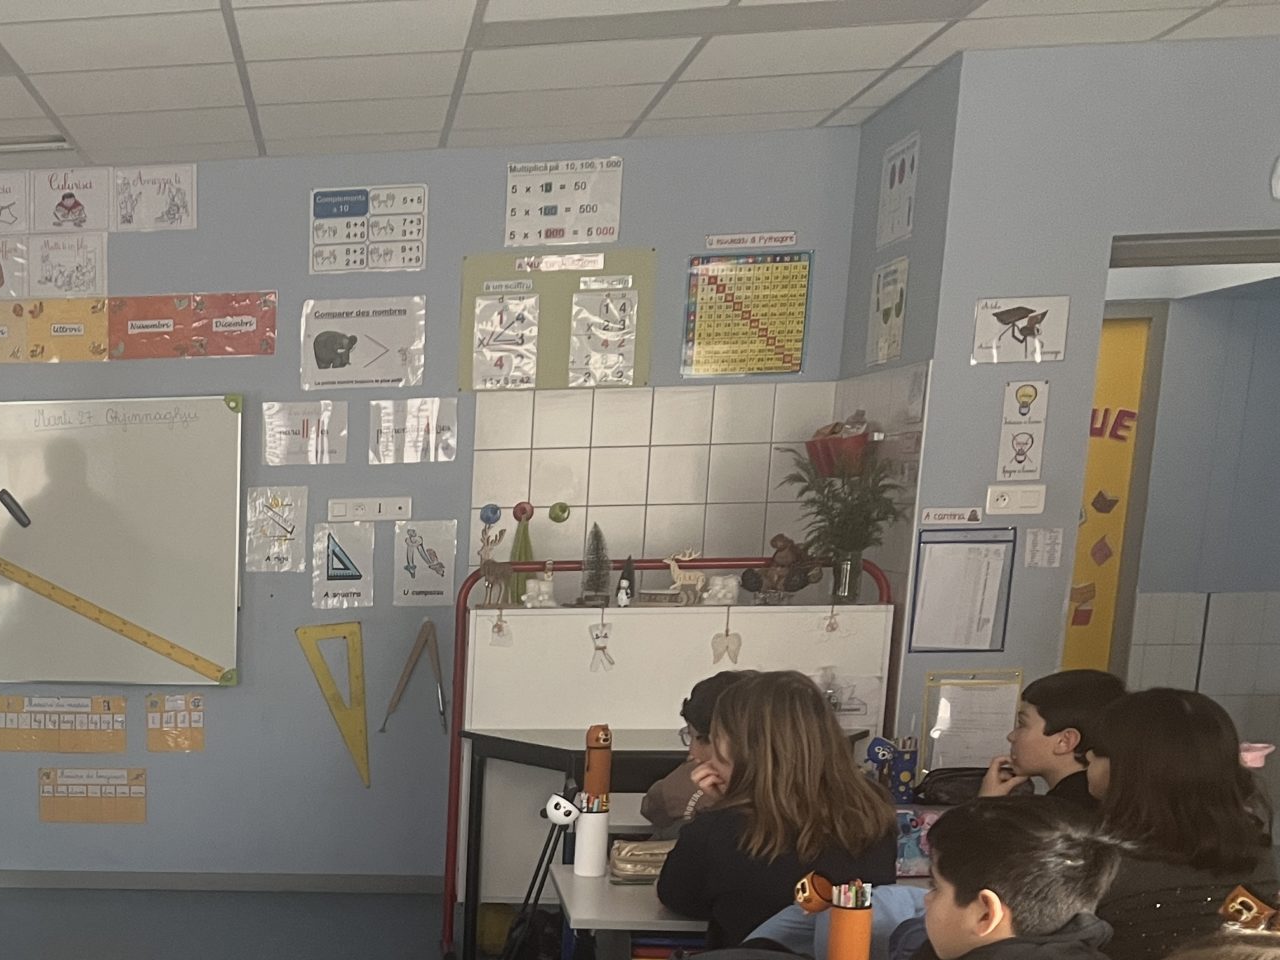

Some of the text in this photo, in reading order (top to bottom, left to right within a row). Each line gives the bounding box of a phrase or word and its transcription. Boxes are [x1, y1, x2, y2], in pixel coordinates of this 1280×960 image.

[511, 185, 517, 193] 5
[540, 182, 552, 193] 10
[574, 181, 587, 191] 50
[510, 208, 516, 216] 5
[538, 205, 558, 216] 100
[579, 204, 598, 214] 500
[509, 231, 515, 239] 5
[587, 227, 593, 236] 5
[596, 226, 615, 236] 000
[314, 307, 407, 319] Comparer des nombres
[619, 302, 626, 313] 4
[497, 311, 504, 325] 1
[494, 356, 504, 369] 4
[79, 410, 94, 425] 27
[924, 511, 966, 521] A cantina
[323, 590, 330, 598] A
[403, 588, 410, 597] U
